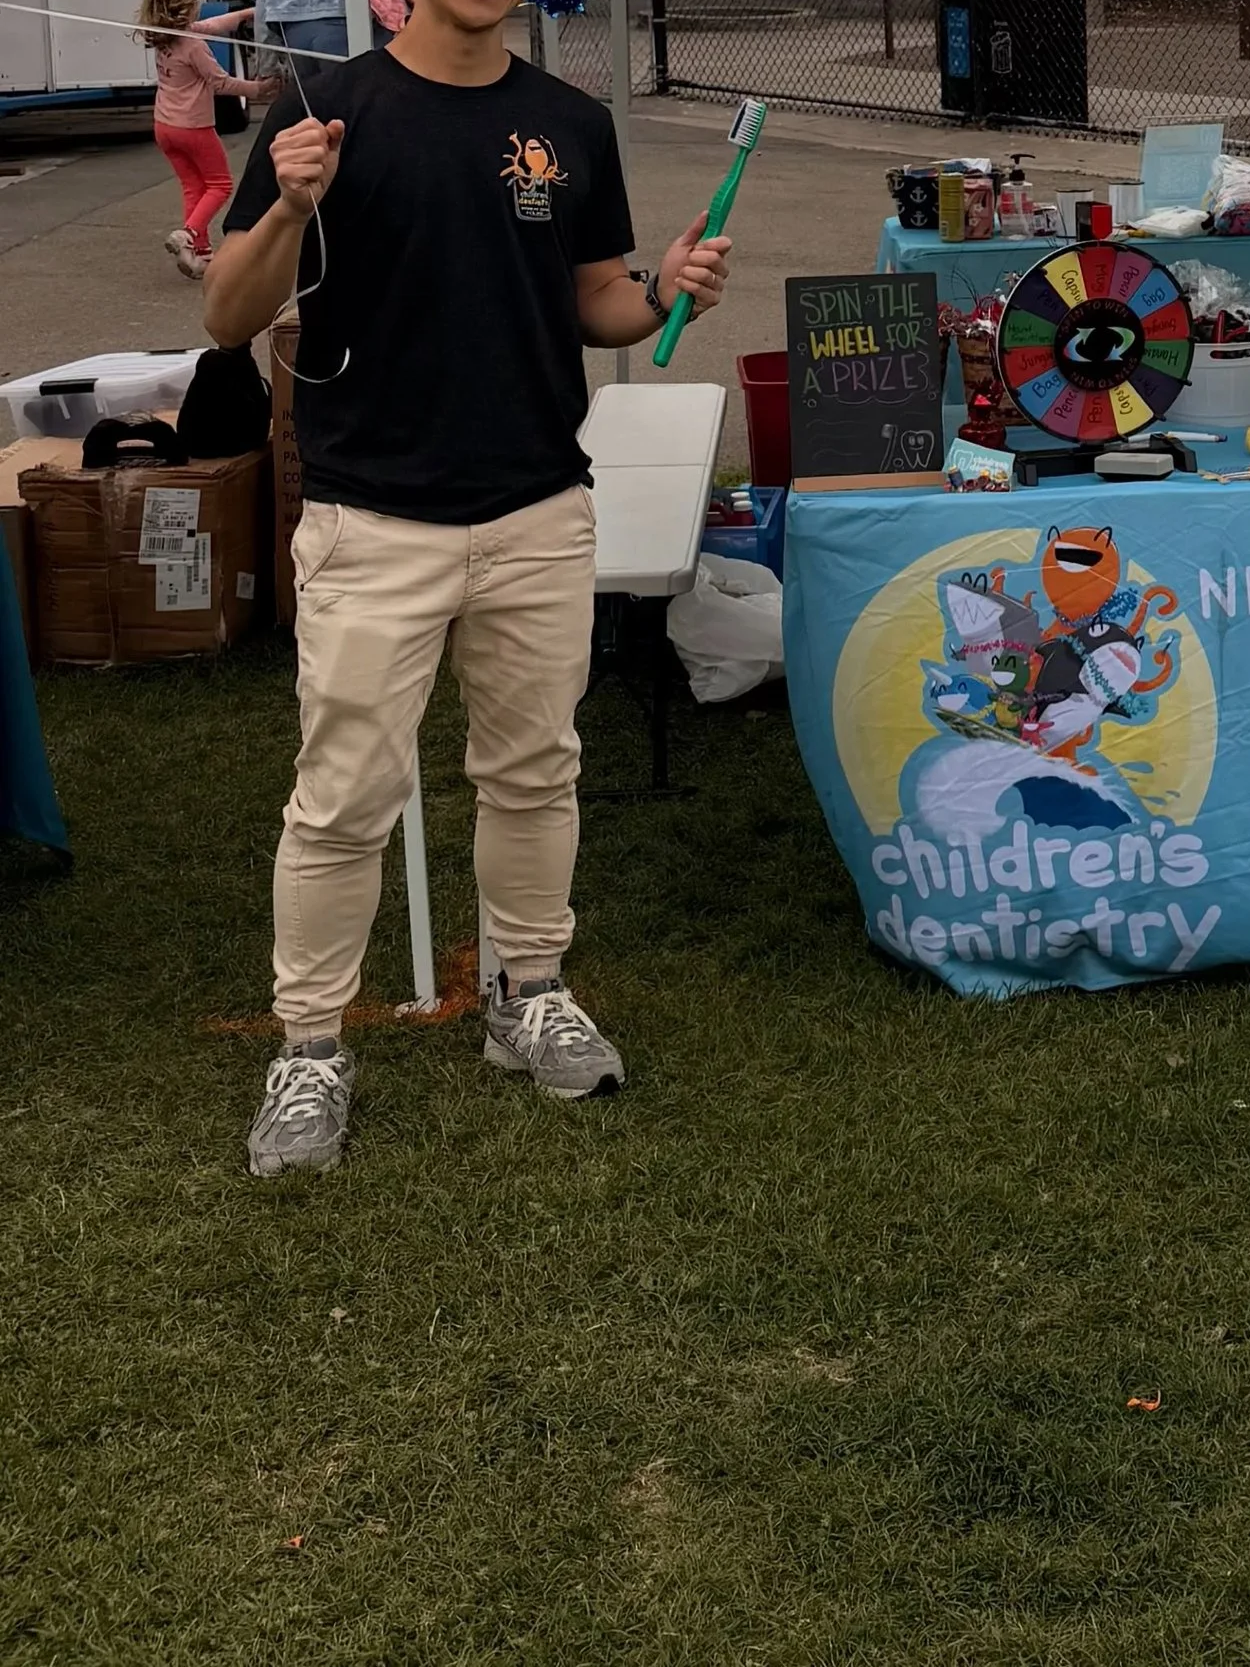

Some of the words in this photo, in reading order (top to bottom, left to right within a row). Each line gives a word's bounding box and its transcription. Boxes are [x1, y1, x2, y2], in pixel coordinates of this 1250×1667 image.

[800, 287, 862, 324] SPIN
[869, 283, 924, 318] THE
[810, 325, 880, 360] WHEEL
[886, 321, 928, 351] FOR
[803, 367, 822, 394] A
[832, 353, 918, 392] PRIZE
[872, 820, 1209, 900] children's
[877, 892, 1222, 974] dentistry
